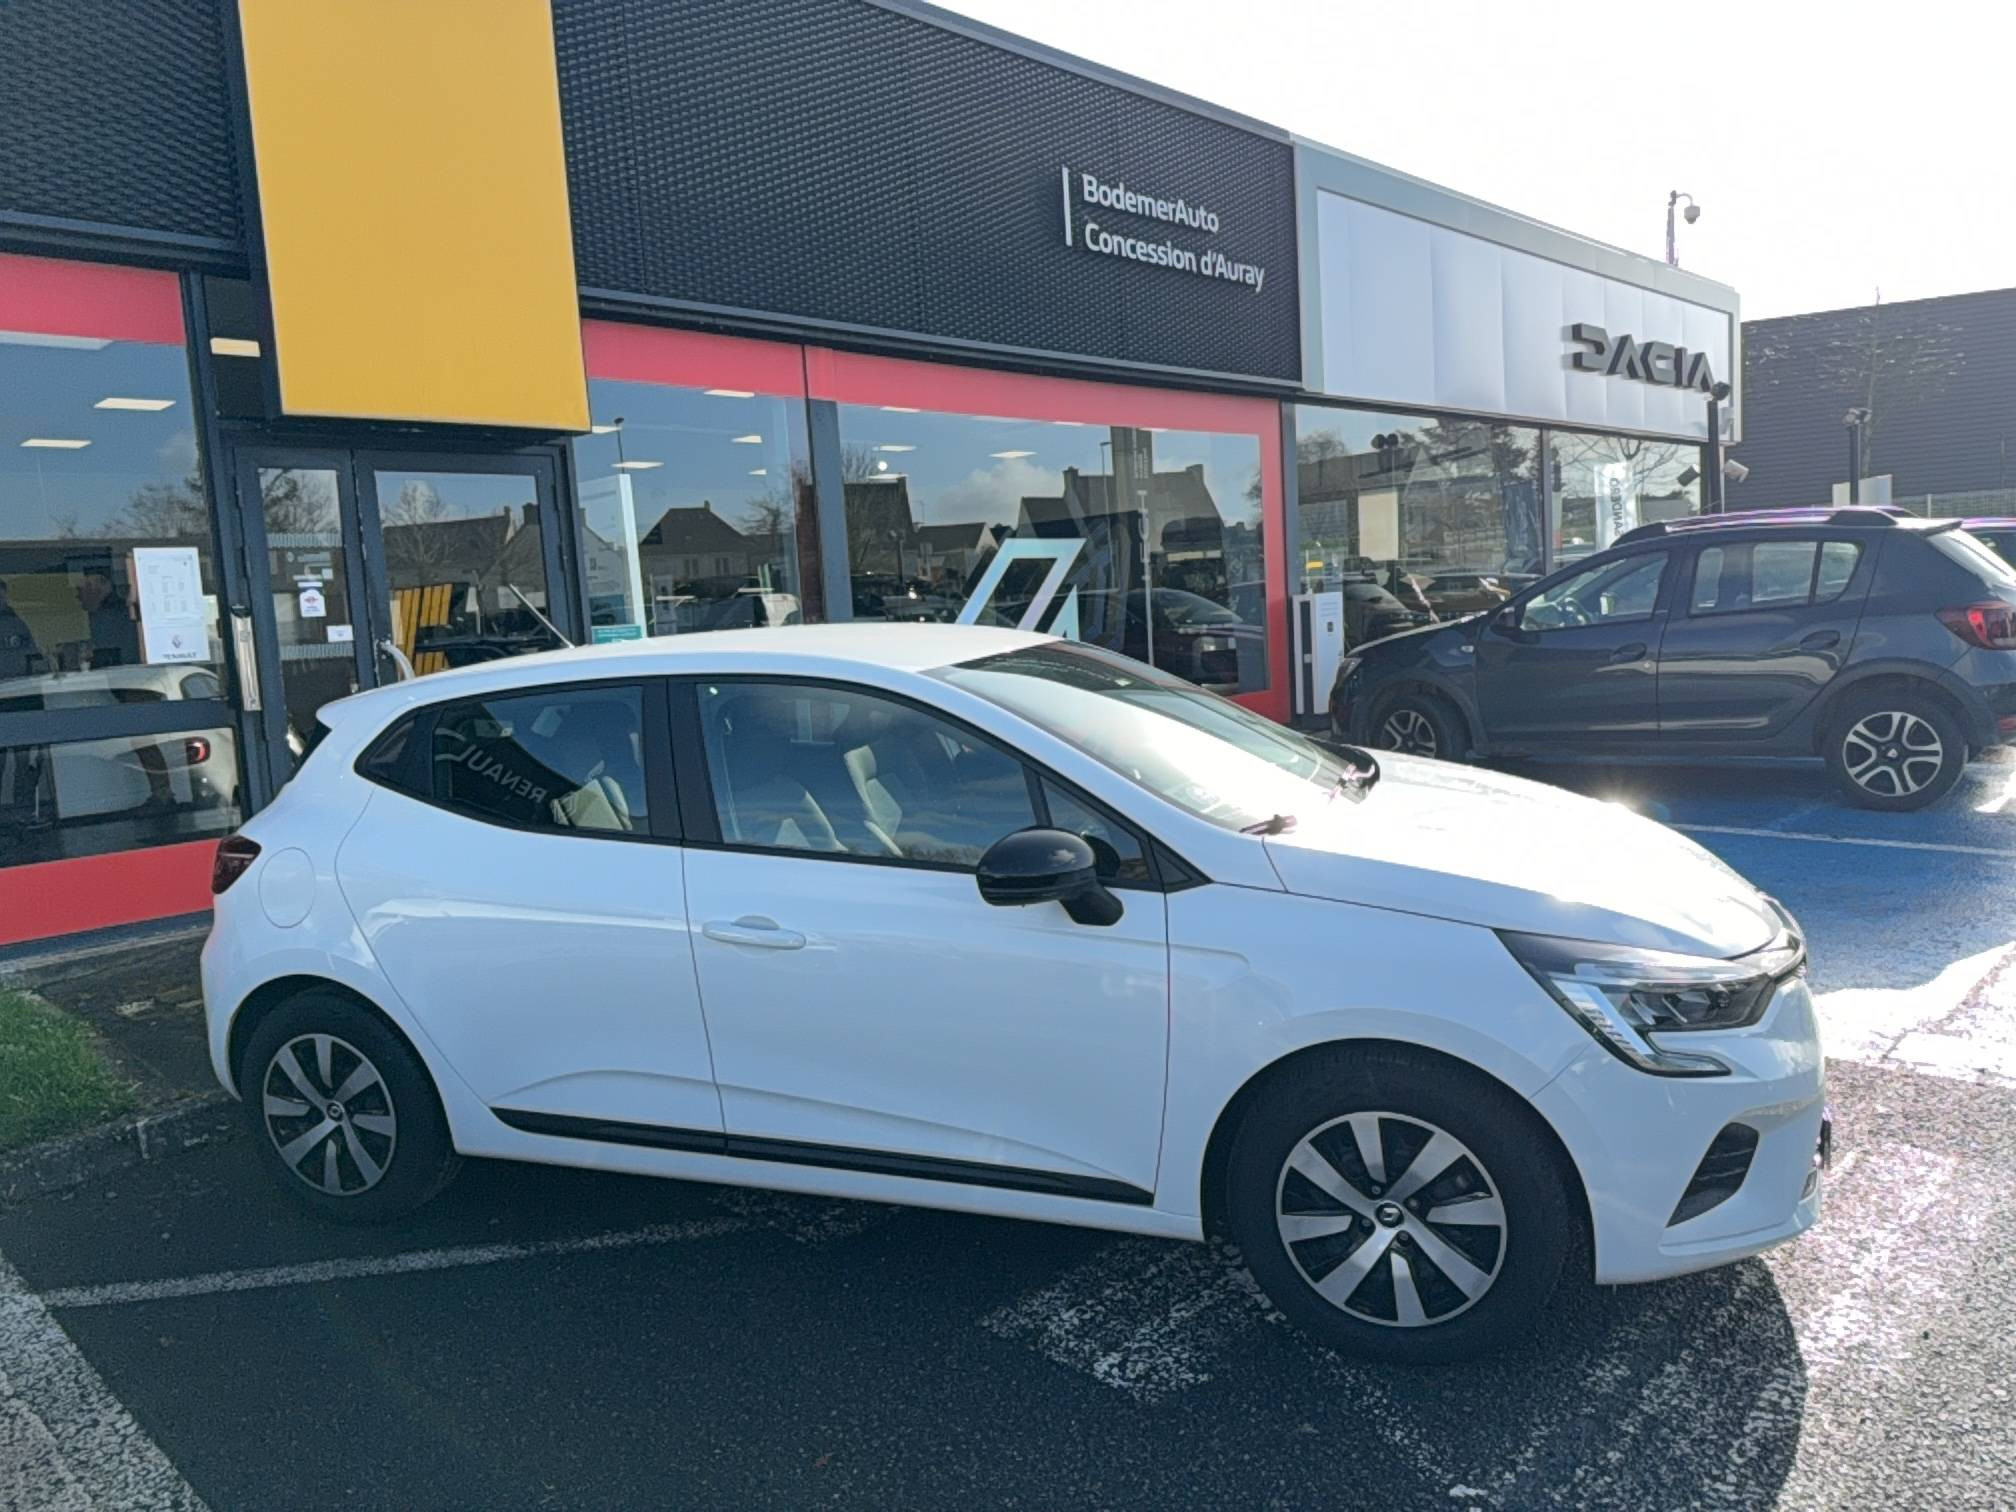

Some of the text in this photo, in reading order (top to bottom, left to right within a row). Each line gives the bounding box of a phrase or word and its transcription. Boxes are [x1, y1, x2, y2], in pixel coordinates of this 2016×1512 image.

[1082, 173, 1219, 233] BodemerAuto
[1085, 222, 1265, 293] Concession d'Auray
[1569, 322, 1715, 393] DACIA
